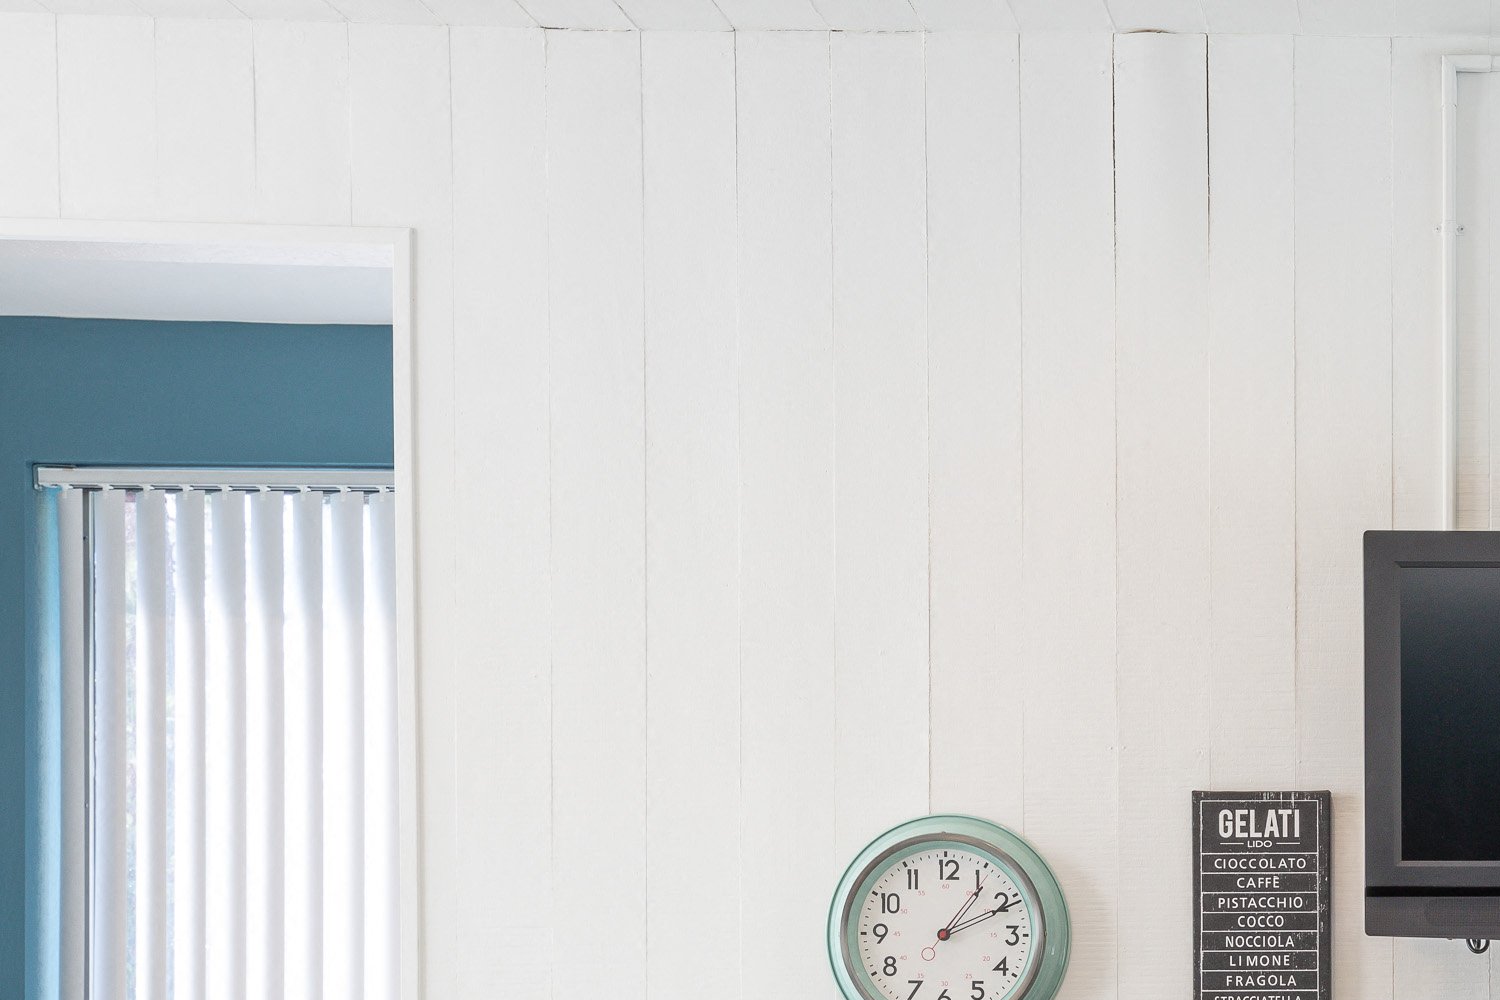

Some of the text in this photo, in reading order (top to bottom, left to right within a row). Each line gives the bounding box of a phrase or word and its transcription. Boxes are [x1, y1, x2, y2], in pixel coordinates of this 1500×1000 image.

[1218, 809, 1300, 839] GELATI
[1247, 840, 1272, 848] LIDO
[939, 859, 960, 880] 12
[1214, 858, 1307, 869] CIOCCOLATO
[907, 869, 919, 890] 11
[1236, 876, 1280, 889] CAFFÈ
[881, 893, 900, 914] 10
[994, 892, 1009, 913] 2
[1218, 897, 1303, 909] PISTACCHIO
[1237, 915, 1284, 927] COCCO
[873, 923, 888, 944] 9
[1005, 925, 1020, 946] 3
[1225, 935, 1294, 948] NOCCIOLA
[883, 956, 898, 977] 8
[992, 956, 1009, 976] 4
[1230, 955, 1290, 967] LIMONE
[908, 980, 923, 1000] 7
[970, 981, 985, 1000] 5
[1226, 975, 1296, 986] FRAGOLA
